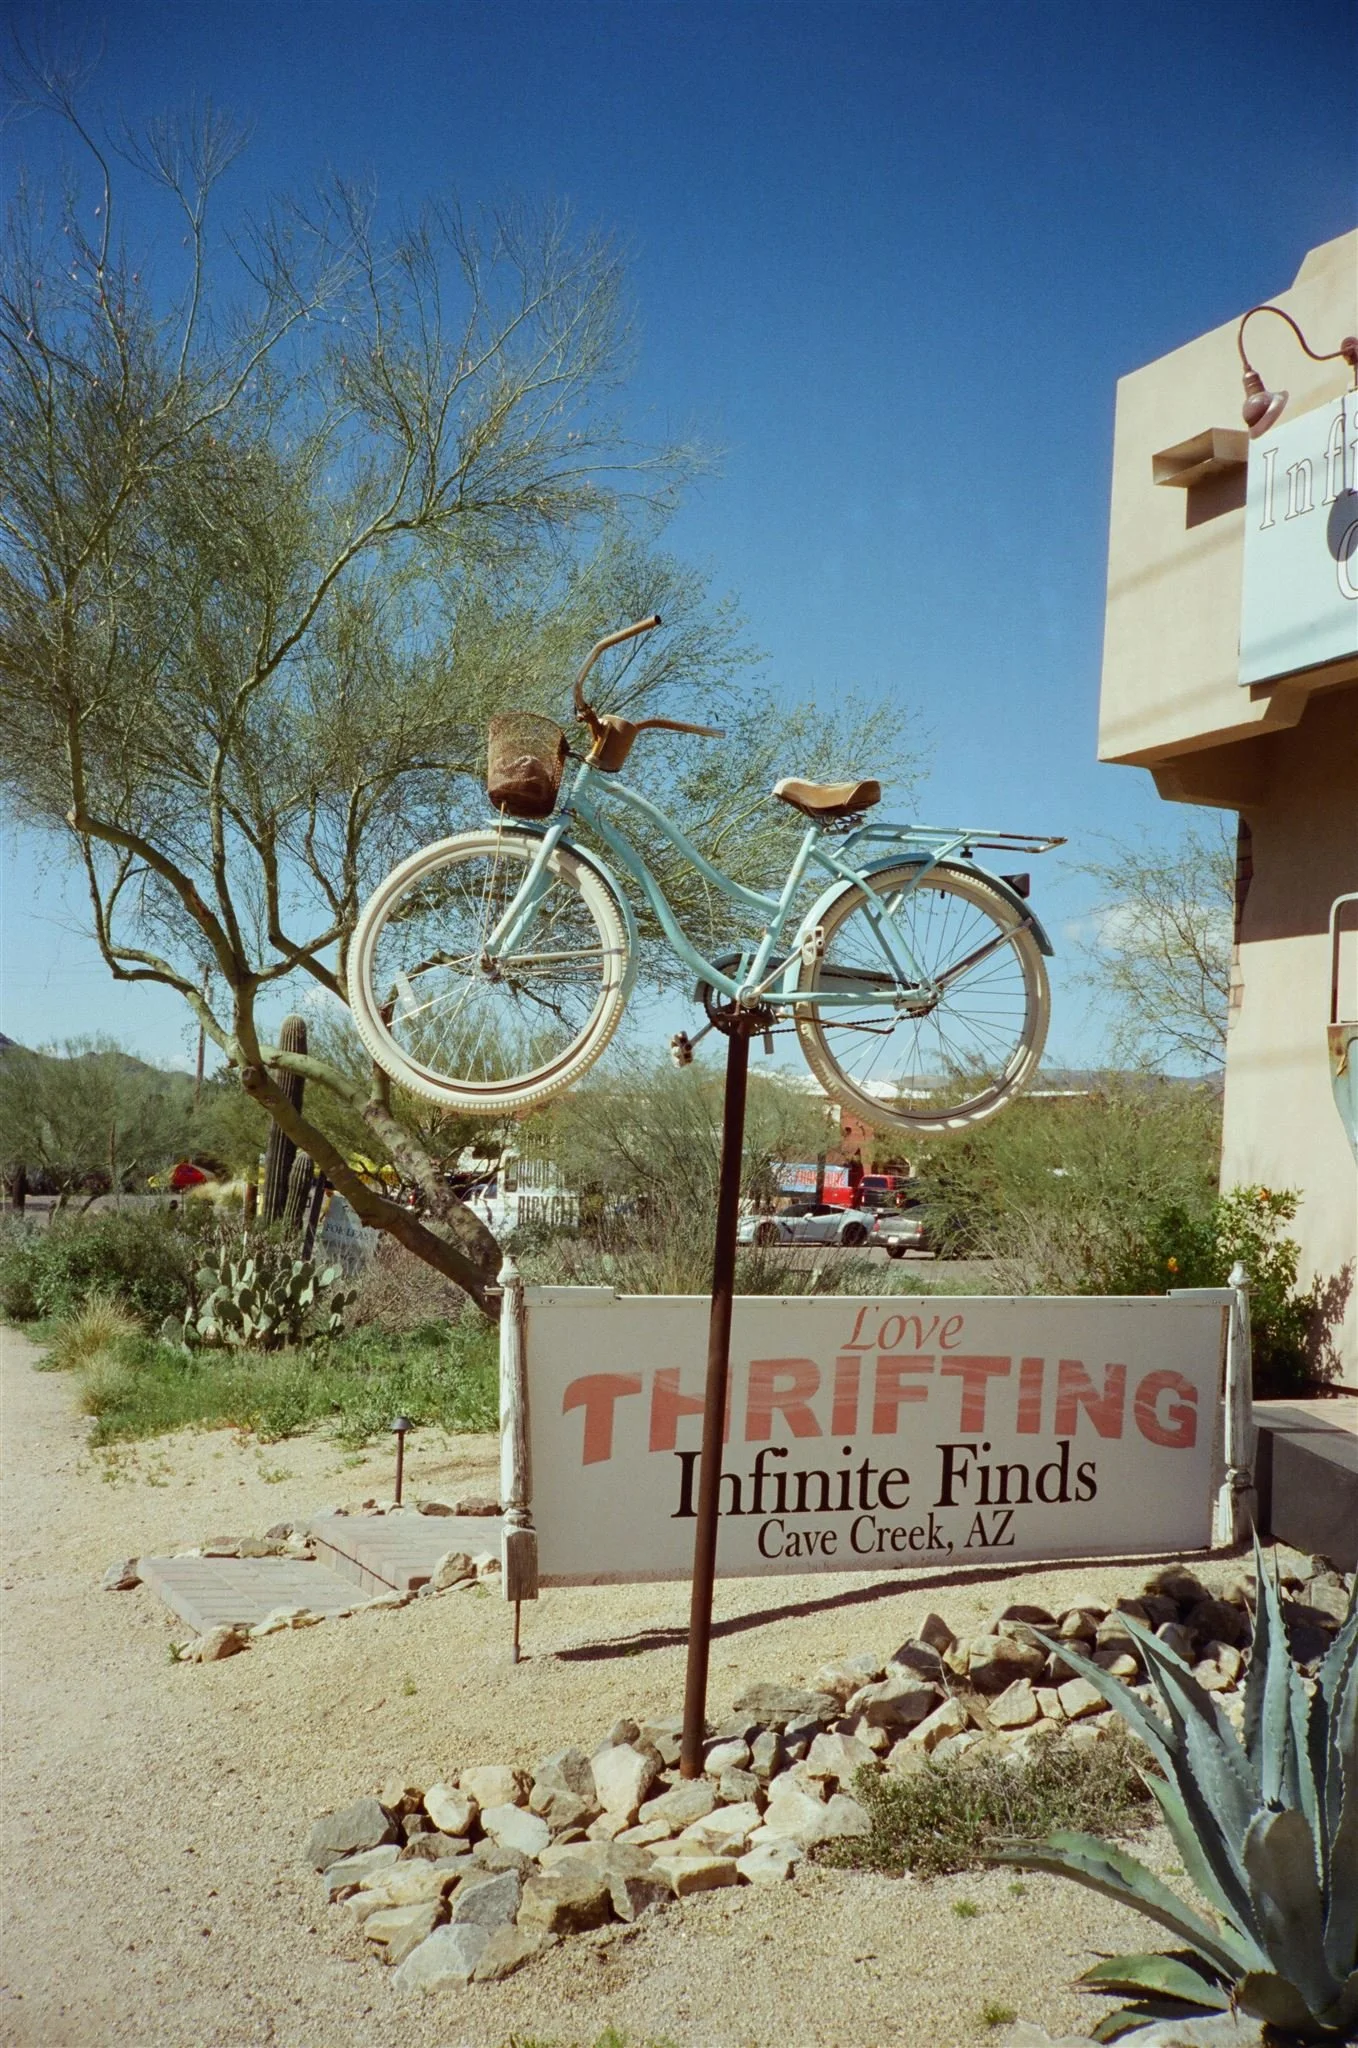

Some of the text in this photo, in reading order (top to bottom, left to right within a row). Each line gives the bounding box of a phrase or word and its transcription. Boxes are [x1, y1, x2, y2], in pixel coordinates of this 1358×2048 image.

[840, 1305, 964, 1351] Love
[562, 1354, 1199, 1466] THRIFTING
[670, 1440, 1098, 1519] Infinite Finds
[758, 1509, 1016, 1559] Cave Creek, AZ
